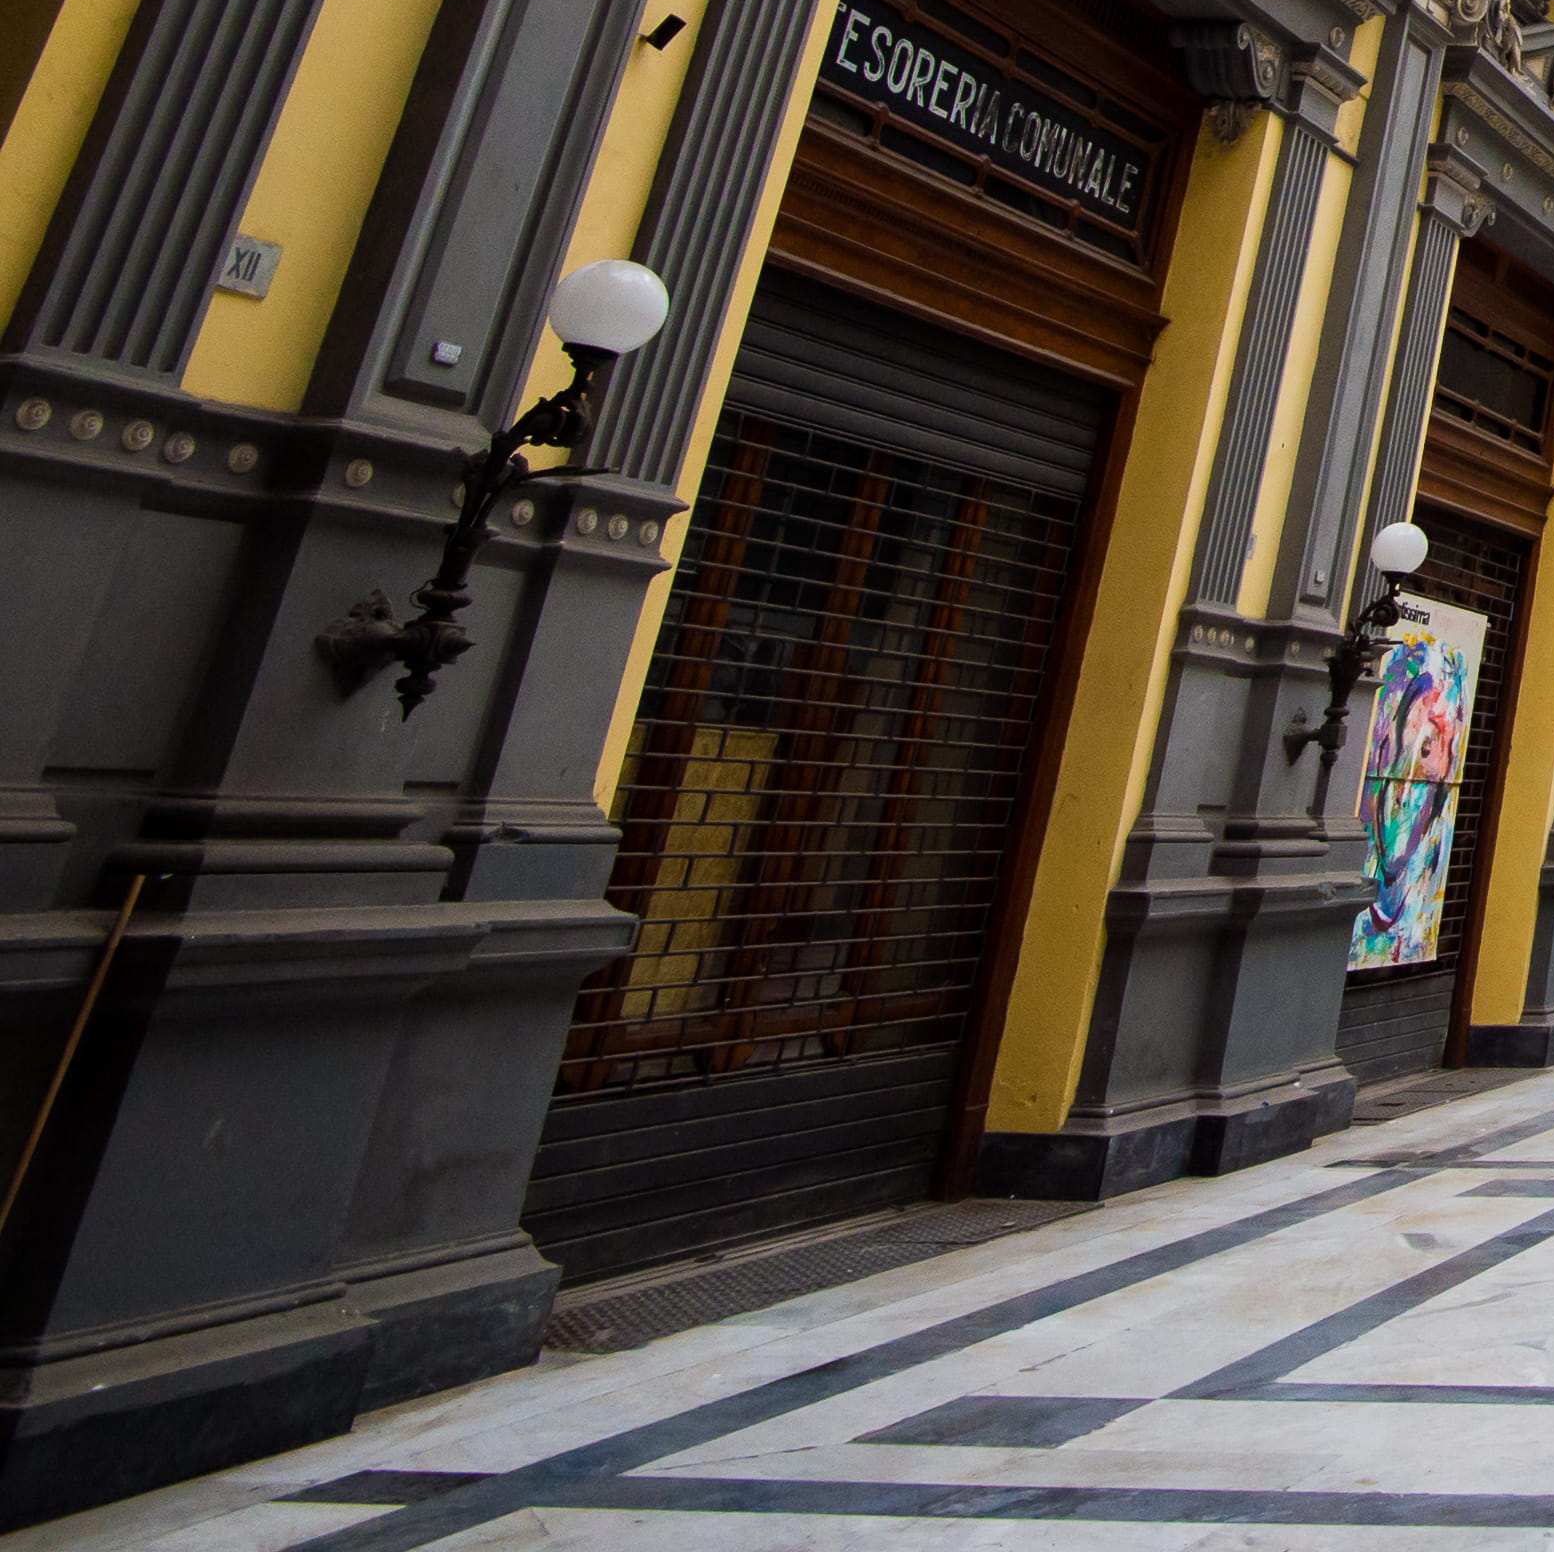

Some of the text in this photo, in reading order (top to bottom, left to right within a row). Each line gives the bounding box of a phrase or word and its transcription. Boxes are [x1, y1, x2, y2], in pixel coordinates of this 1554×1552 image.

[837, 1, 1139, 214] ESORERIA COMUNALE
[226, 246, 263, 282] XII
